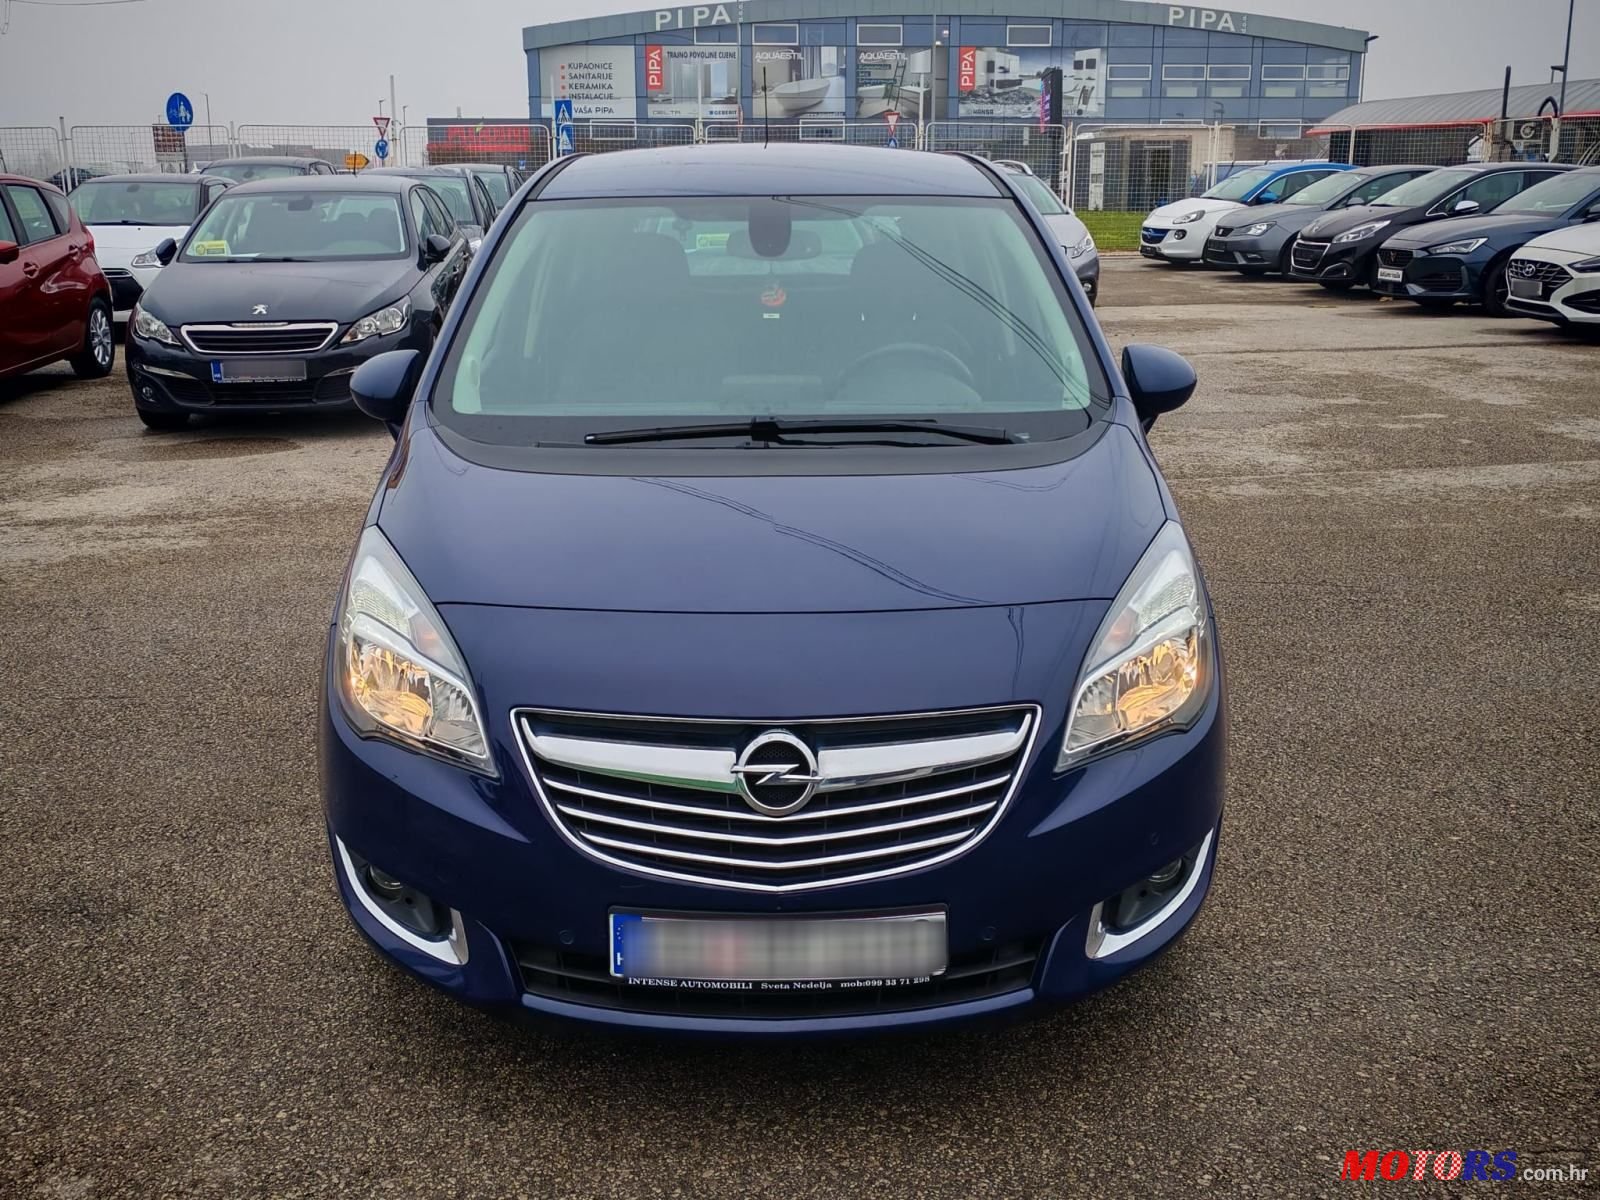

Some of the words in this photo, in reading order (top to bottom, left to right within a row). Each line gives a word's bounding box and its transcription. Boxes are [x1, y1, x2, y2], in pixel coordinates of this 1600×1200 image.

[655, 4, 732, 32] PIPA
[1168, 6, 1236, 33] PIPA
[667, 51, 688, 59] TRAJNO
[689, 51, 717, 59] POVOLJNE
[718, 51, 736, 59] CIJENE
[755, 50, 804, 62] AQUAESTIL
[859, 50, 908, 62] AQUAESTIL
[568, 62, 613, 70] KUPAONICE
[648, 49, 661, 86] PIPA
[961, 50, 974, 87] PIPA
[568, 72, 613, 80] SANITARIJE
[568, 82, 613, 90] KERAMIKA
[573, 105, 593, 114] VAŠA
[595, 106, 614, 114] PIPA
[628, 977, 678, 987] INTENSE
[680, 981, 753, 990] AUTOMOBILI
[761, 982, 790, 990] Sveta
[792, 981, 832, 990] Nedelja
[840, 979, 883, 988] mob:099
[885, 979, 897, 987] 33
